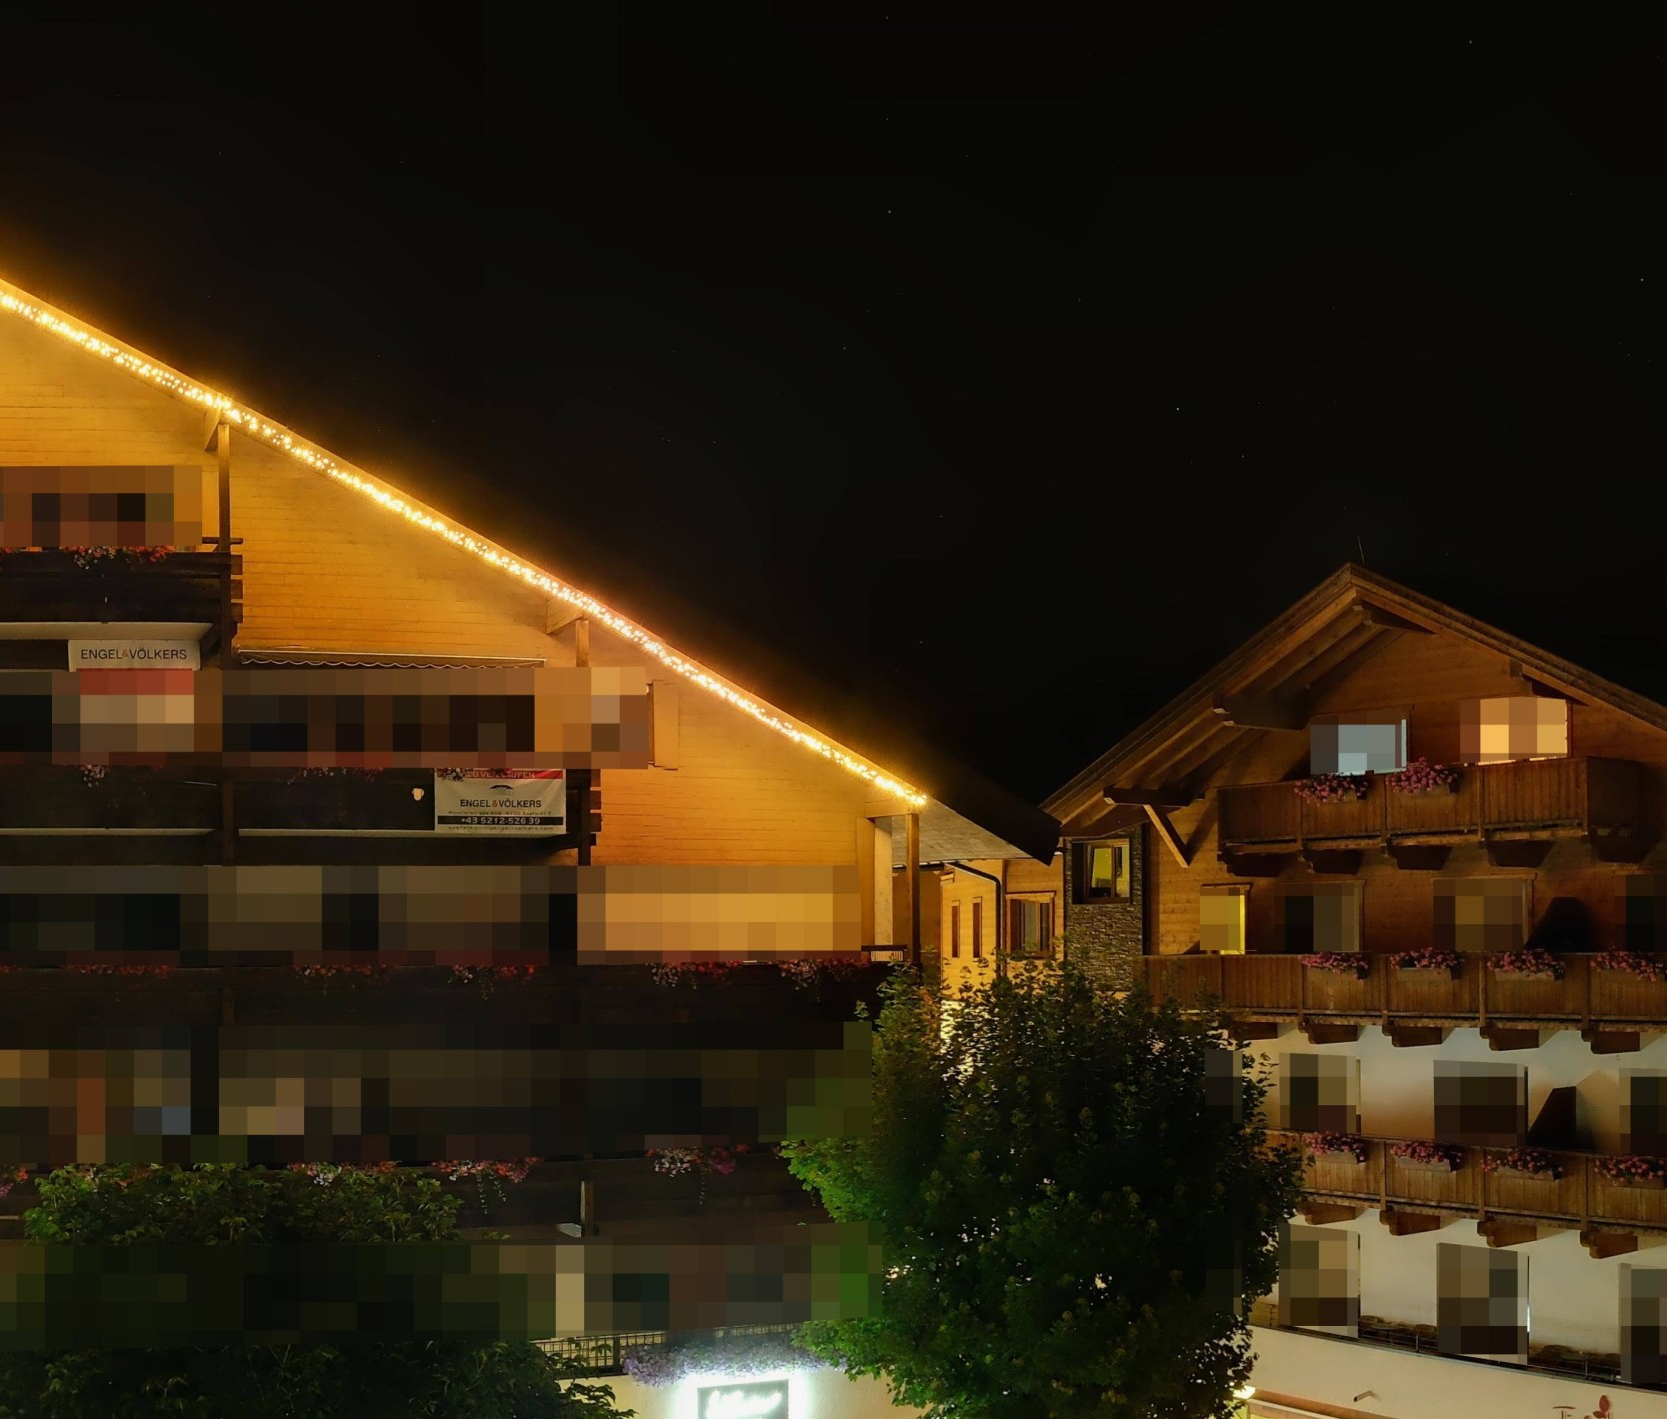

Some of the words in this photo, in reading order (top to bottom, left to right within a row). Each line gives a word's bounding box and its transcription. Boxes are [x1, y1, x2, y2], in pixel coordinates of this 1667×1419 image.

[80, 647, 187, 660] ENGEL&VÖLKERS
[481, 770, 535, 778] VEAUFEN
[460, 797, 542, 808] ENGEL&VÖLKERS
